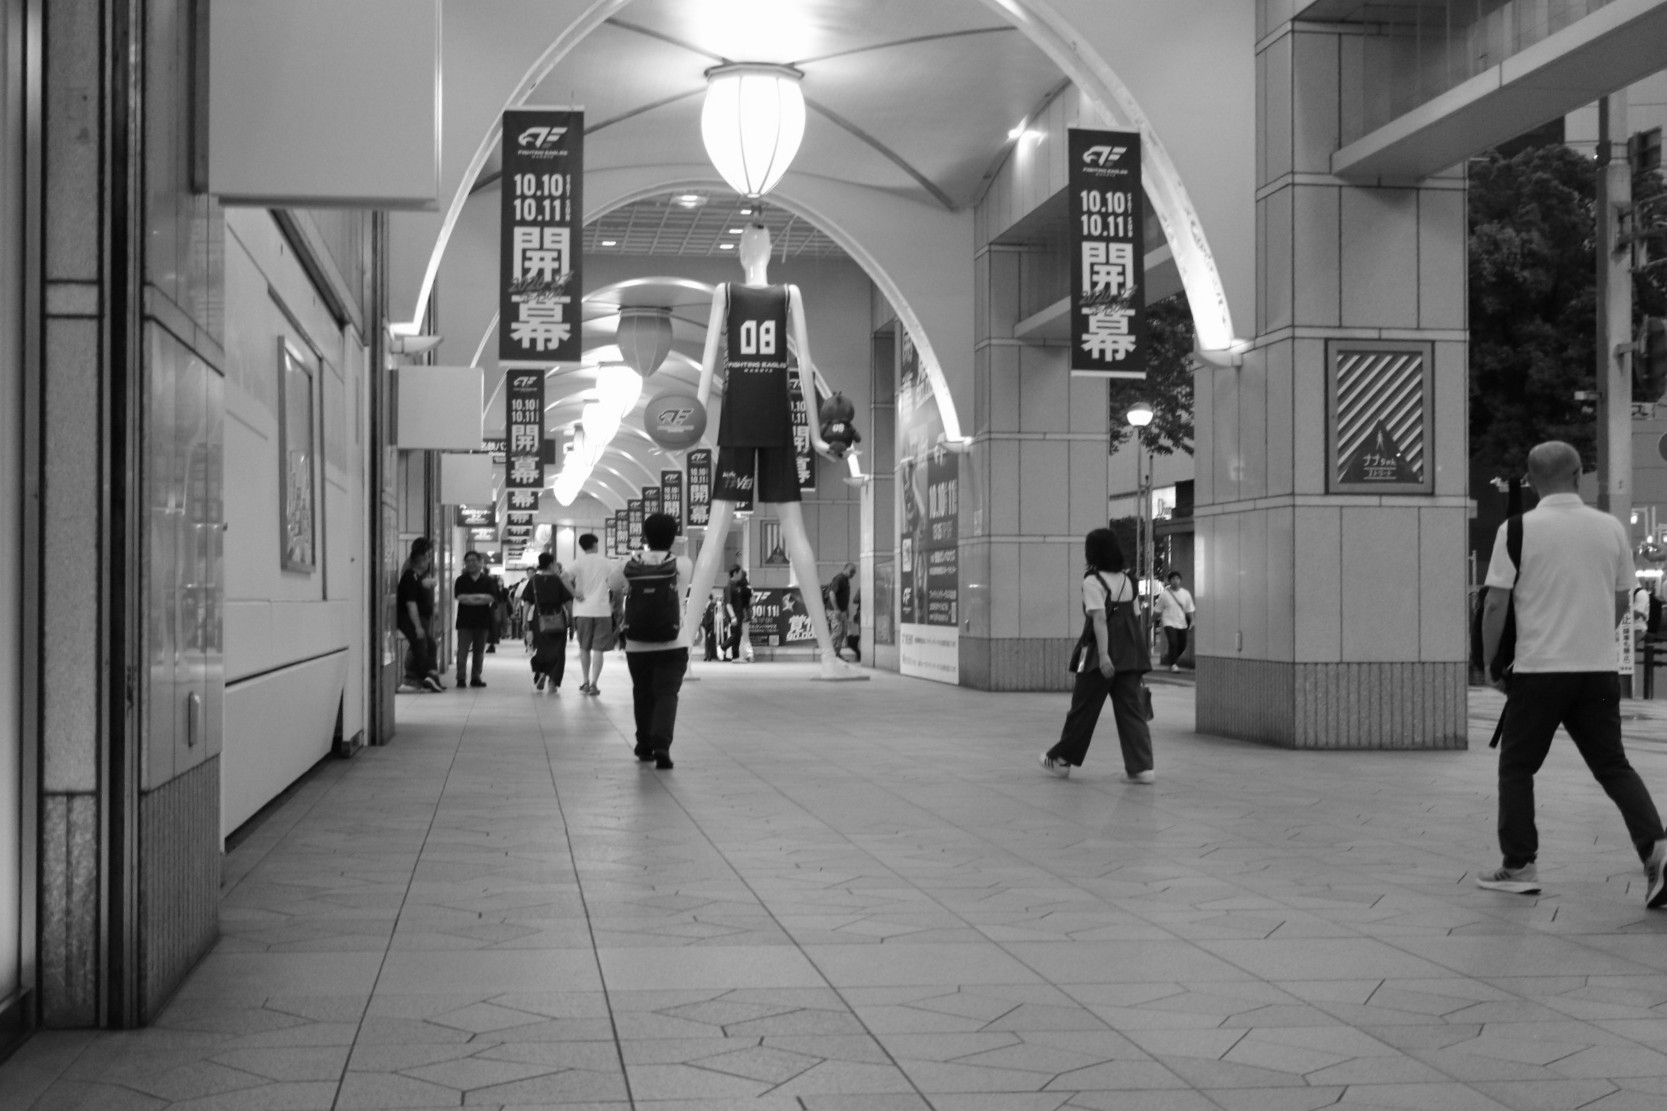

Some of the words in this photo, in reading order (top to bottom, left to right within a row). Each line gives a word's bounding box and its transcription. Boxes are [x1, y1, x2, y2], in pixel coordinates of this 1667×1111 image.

[514, 173, 564, 197] 10.10
[513, 197, 561, 221] 10.11
[1080, 189, 1125, 214] 10.10
[1080, 213, 1124, 238] 10.11
[510, 226, 572, 352] 開幕
[1081, 241, 1137, 362] 開幕
[740, 320, 776, 355] 08
[512, 399, 536, 411] 10.10
[512, 411, 535, 423] 10.11
[511, 424, 540, 484] 開幕
